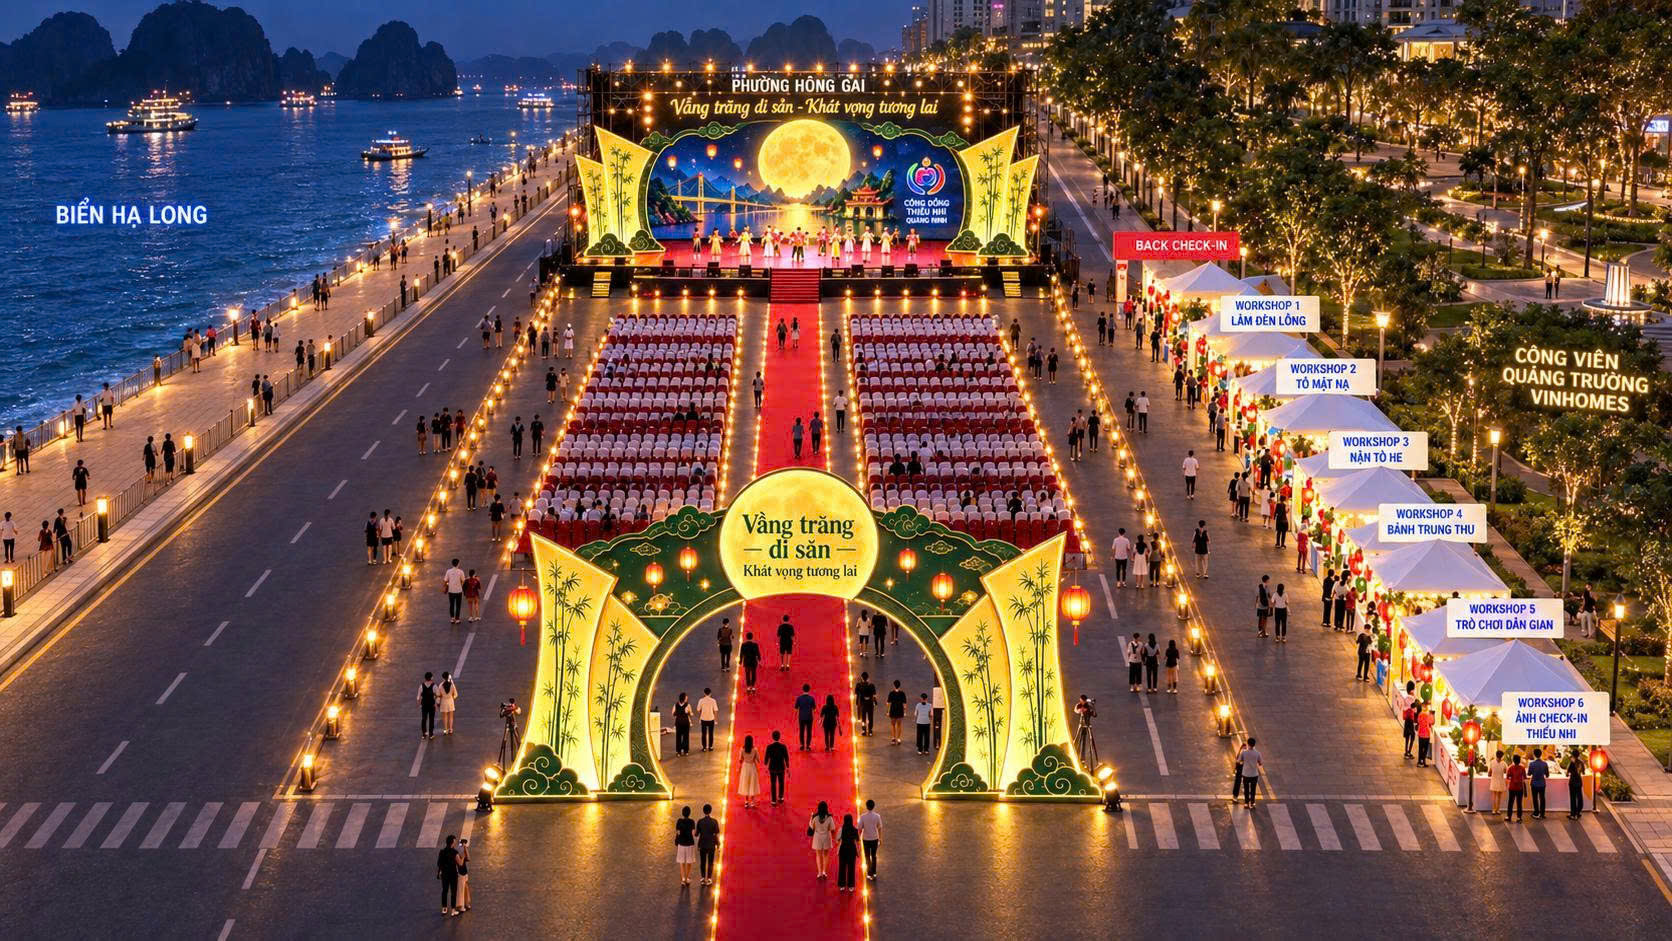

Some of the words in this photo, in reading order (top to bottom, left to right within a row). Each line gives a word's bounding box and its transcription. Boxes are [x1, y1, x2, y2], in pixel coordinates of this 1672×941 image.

[841, 78, 865, 92] GAI
[714, 98, 750, 119] trăng
[754, 98, 768, 114] di
[804, 97, 840, 115] Khát
[920, 98, 938, 114] lai
[1135, 240, 1168, 251] BACK
[1172, 240, 1228, 251] CHECK-IN
[1235, 300, 1292, 310] WORKSHOP
[1295, 300, 1301, 310] 1
[1290, 363, 1347, 374] WORKSHOP
[1350, 363, 1357, 374] 2
[1336, 379, 1350, 392] NẠ
[1343, 436, 1400, 447] WORKSHOP
[1403, 436, 1409, 447] 3
[1389, 452, 1403, 463] HE
[1396, 508, 1453, 519] WORKSHOP
[1456, 508, 1463, 519] 4
[742, 511, 793, 539] Vầng
[799, 515, 855, 540] trăng
[1418, 524, 1452, 535] TRUNG
[1455, 524, 1475, 535] THU
[769, 538, 788, 559] di
[743, 564, 772, 577] Khát
[775, 568, 803, 580] vọng
[807, 565, 840, 580] tương
[843, 564, 857, 577] lai
[1469, 603, 1527, 614] WORKSHOP
[1529, 603, 1536, 614] 5
[1456, 617, 1476, 630] TRÒ
[1478, 619, 1503, 630] CHƠI
[1529, 619, 1554, 630] GIAN
[1518, 697, 1575, 708] WORKSHOP
[1577, 697, 1584, 708] 6
[1539, 713, 1588, 724] CHECK-IN
[1526, 724, 1556, 739] THIẾU
[1559, 729, 1577, 739] NHI
